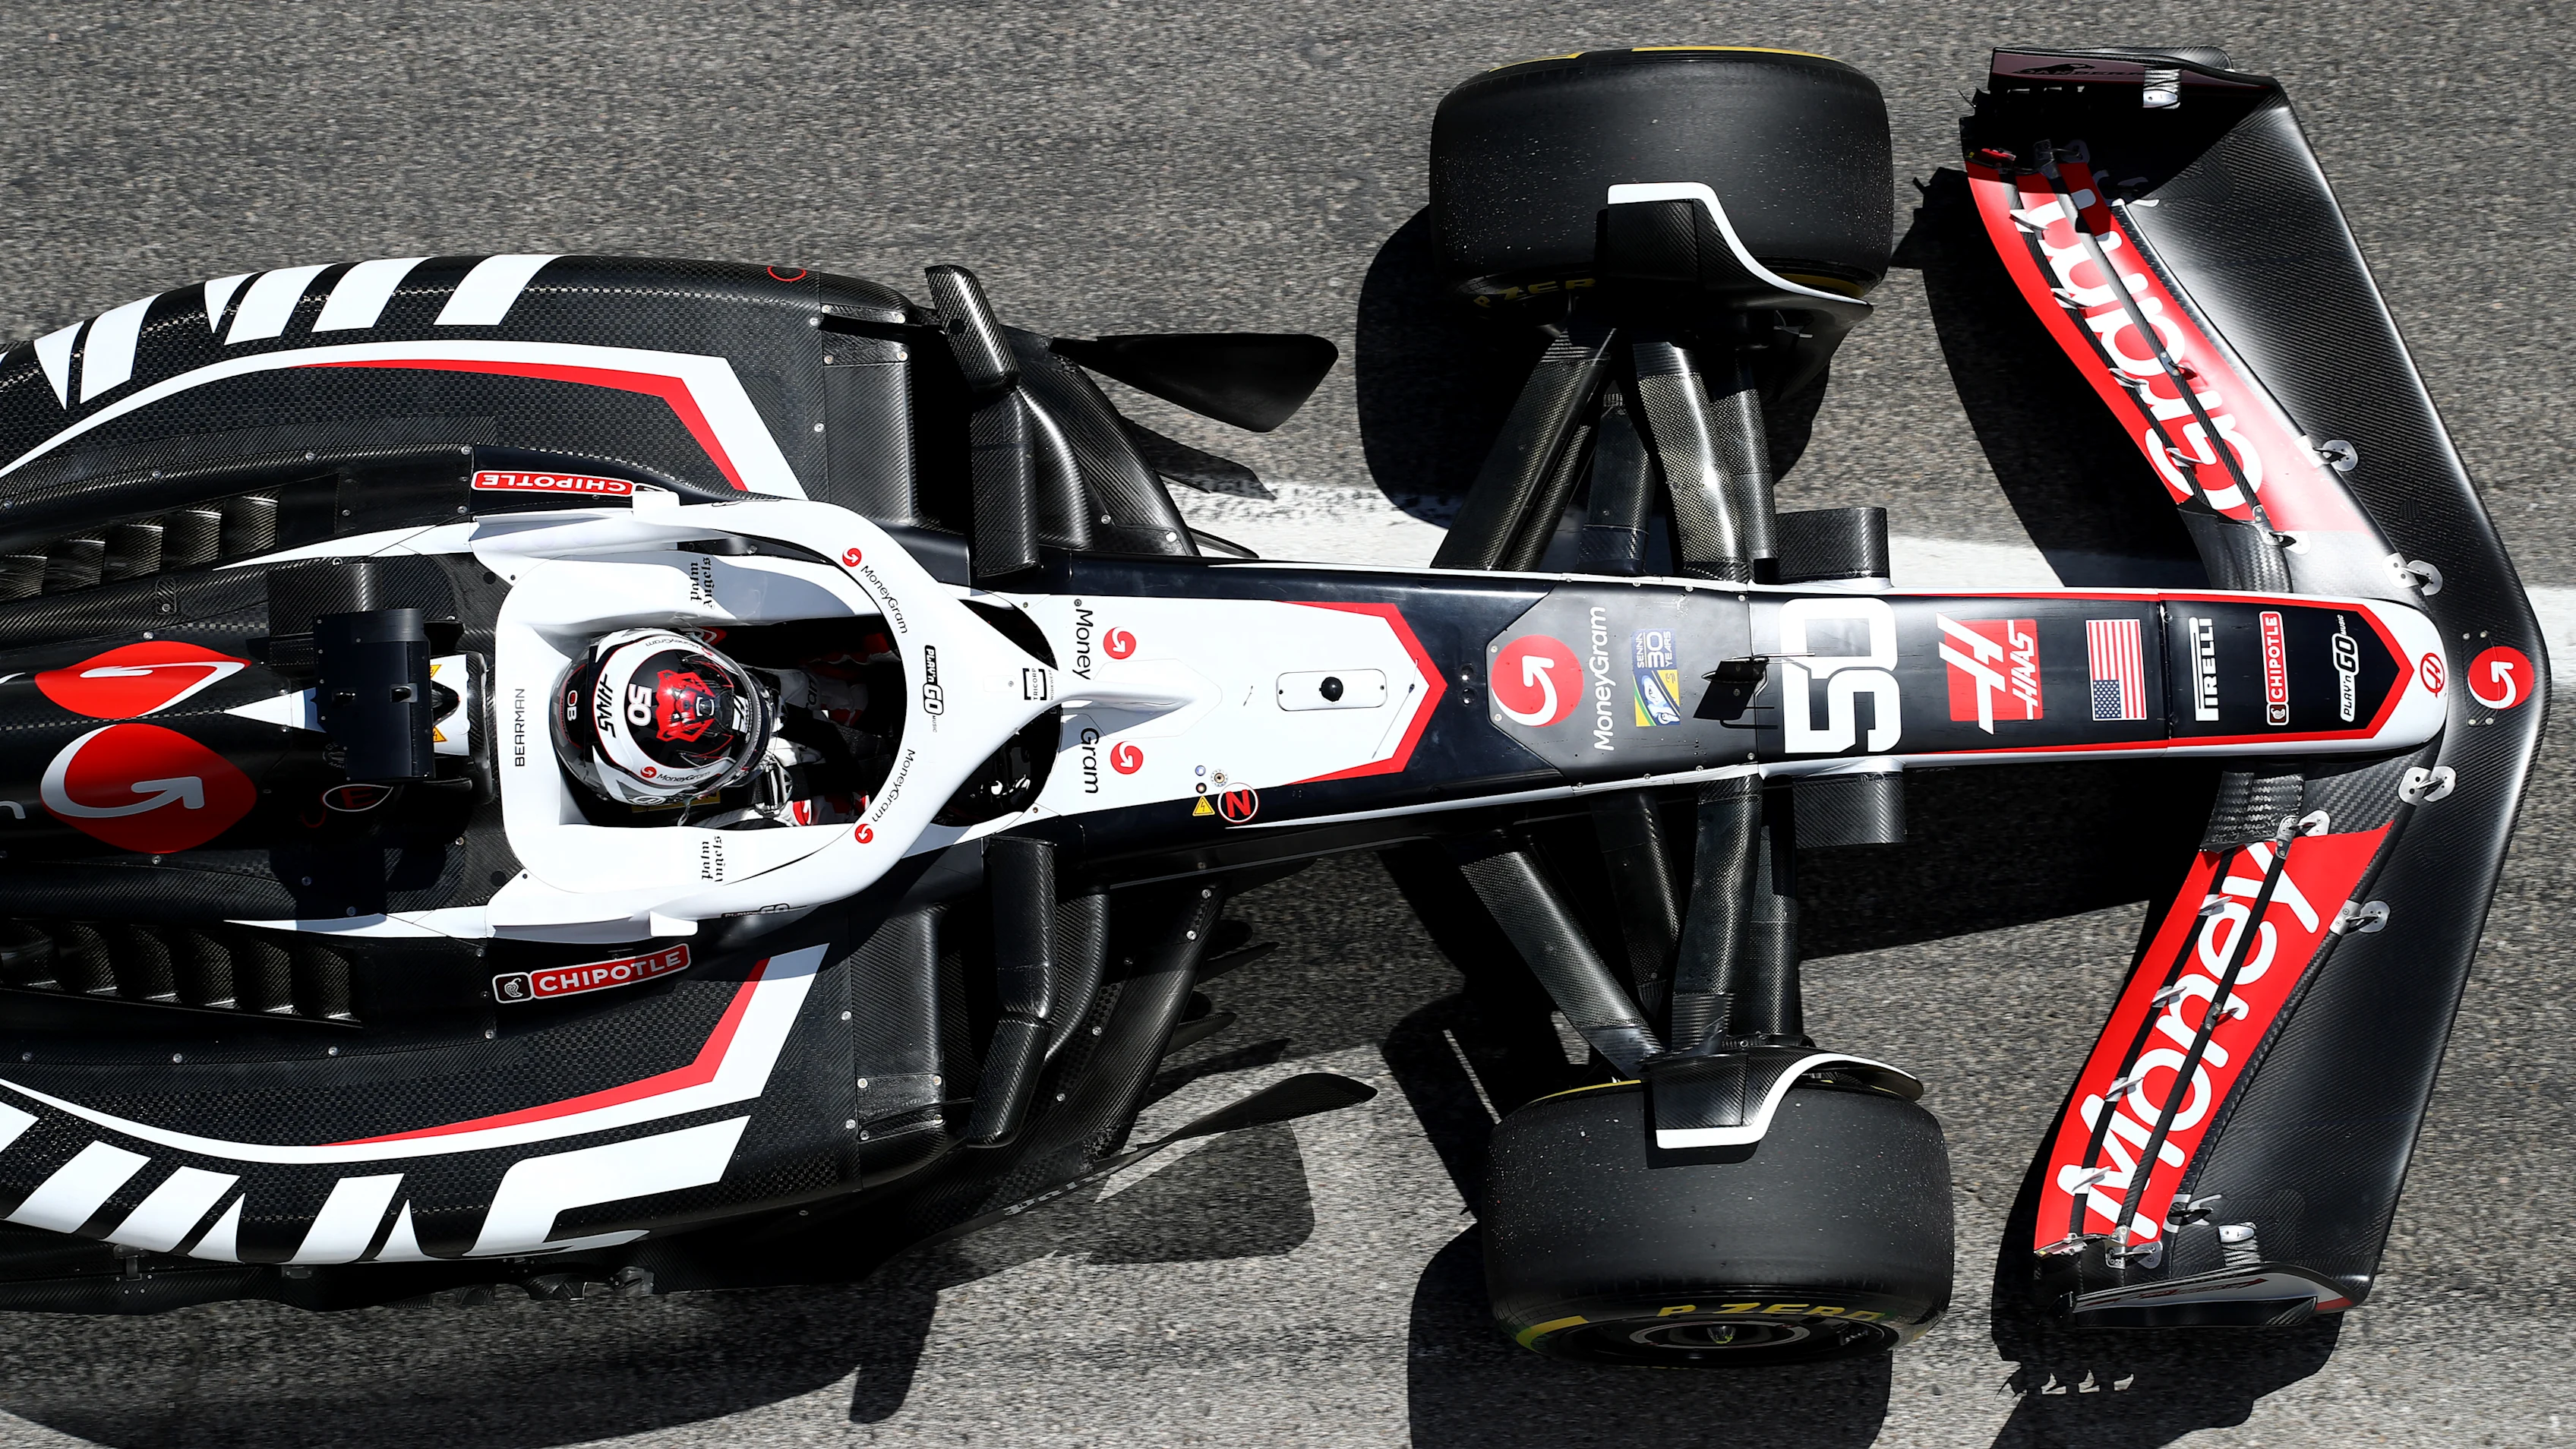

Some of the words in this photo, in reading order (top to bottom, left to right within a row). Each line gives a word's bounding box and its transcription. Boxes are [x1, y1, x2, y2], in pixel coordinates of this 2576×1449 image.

[2016, 189, 2262, 510] Gram
[483, 475, 627, 493] CHIPOTLE
[690, 561, 702, 601] Palm
[702, 557, 715, 609] Angels
[860, 565, 908, 634] MoneyGram
[1072, 608, 1094, 680] Money
[2337, 614, 2347, 635] MUSIC
[1637, 632, 1645, 668] SENNA
[1646, 631, 1665, 668] 30
[1663, 630, 1673, 668] YEARS
[2006, 620, 2038, 720] HAAS
[2189, 617, 2219, 721] PIRELLI
[2265, 616, 2284, 699] CHIPOTLE
[2335, 636, 2356, 673] GO
[1589, 606, 1616, 751] MoneyGram
[1779, 597, 1902, 753] 50
[595, 674, 617, 739] HAAS
[627, 683, 652, 726] 50
[923, 683, 943, 715] GO
[514, 688, 526, 766] BEARMAN
[657, 771, 710, 783] MoneyGram
[1080, 727, 1100, 794] Gram
[872, 749, 916, 822] MoneyGram
[1226, 789, 1251, 818] N
[701, 841, 713, 881] Palm
[538, 950, 682, 993] CHIPOTLE
[2057, 842, 2319, 1239] Money
[1656, 1304, 1697, 1317] P
[1713, 1302, 1886, 1321] ZERO
